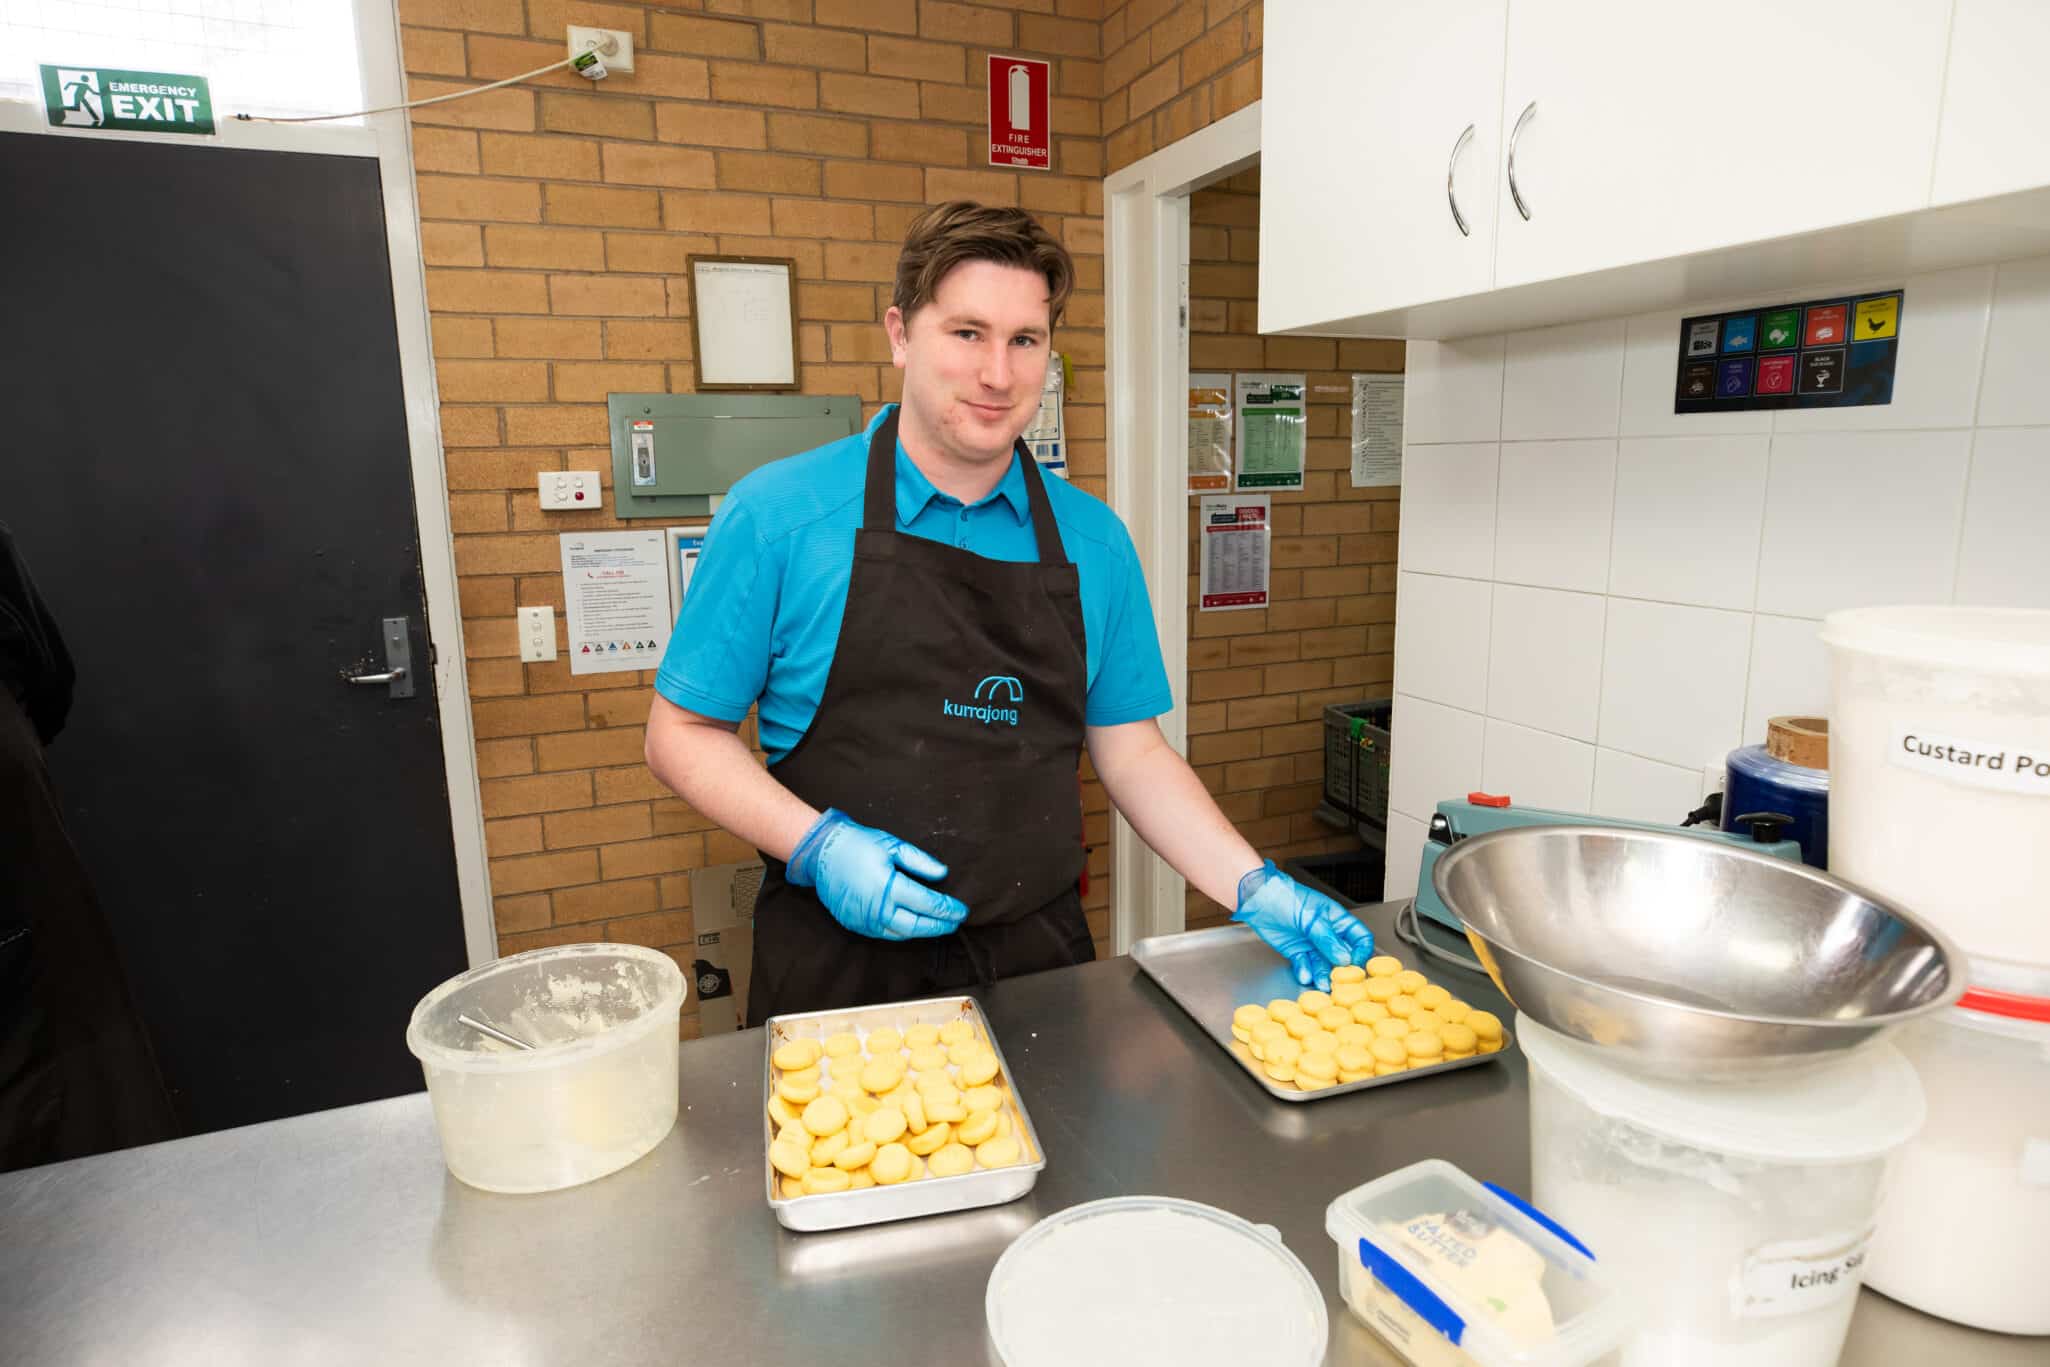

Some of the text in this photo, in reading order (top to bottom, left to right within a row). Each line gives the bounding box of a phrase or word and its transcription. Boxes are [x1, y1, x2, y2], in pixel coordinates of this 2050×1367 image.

[109, 81, 197, 96] EMERGENCY
[111, 94, 200, 123] EXIT
[1008, 133, 1030, 144] FIRE
[991, 143, 1048, 158] EXTINGUISHER
[943, 699, 1018, 726] kurrajong
[1903, 735, 2005, 770] Custard
[1791, 1266, 1841, 1289] Icing
